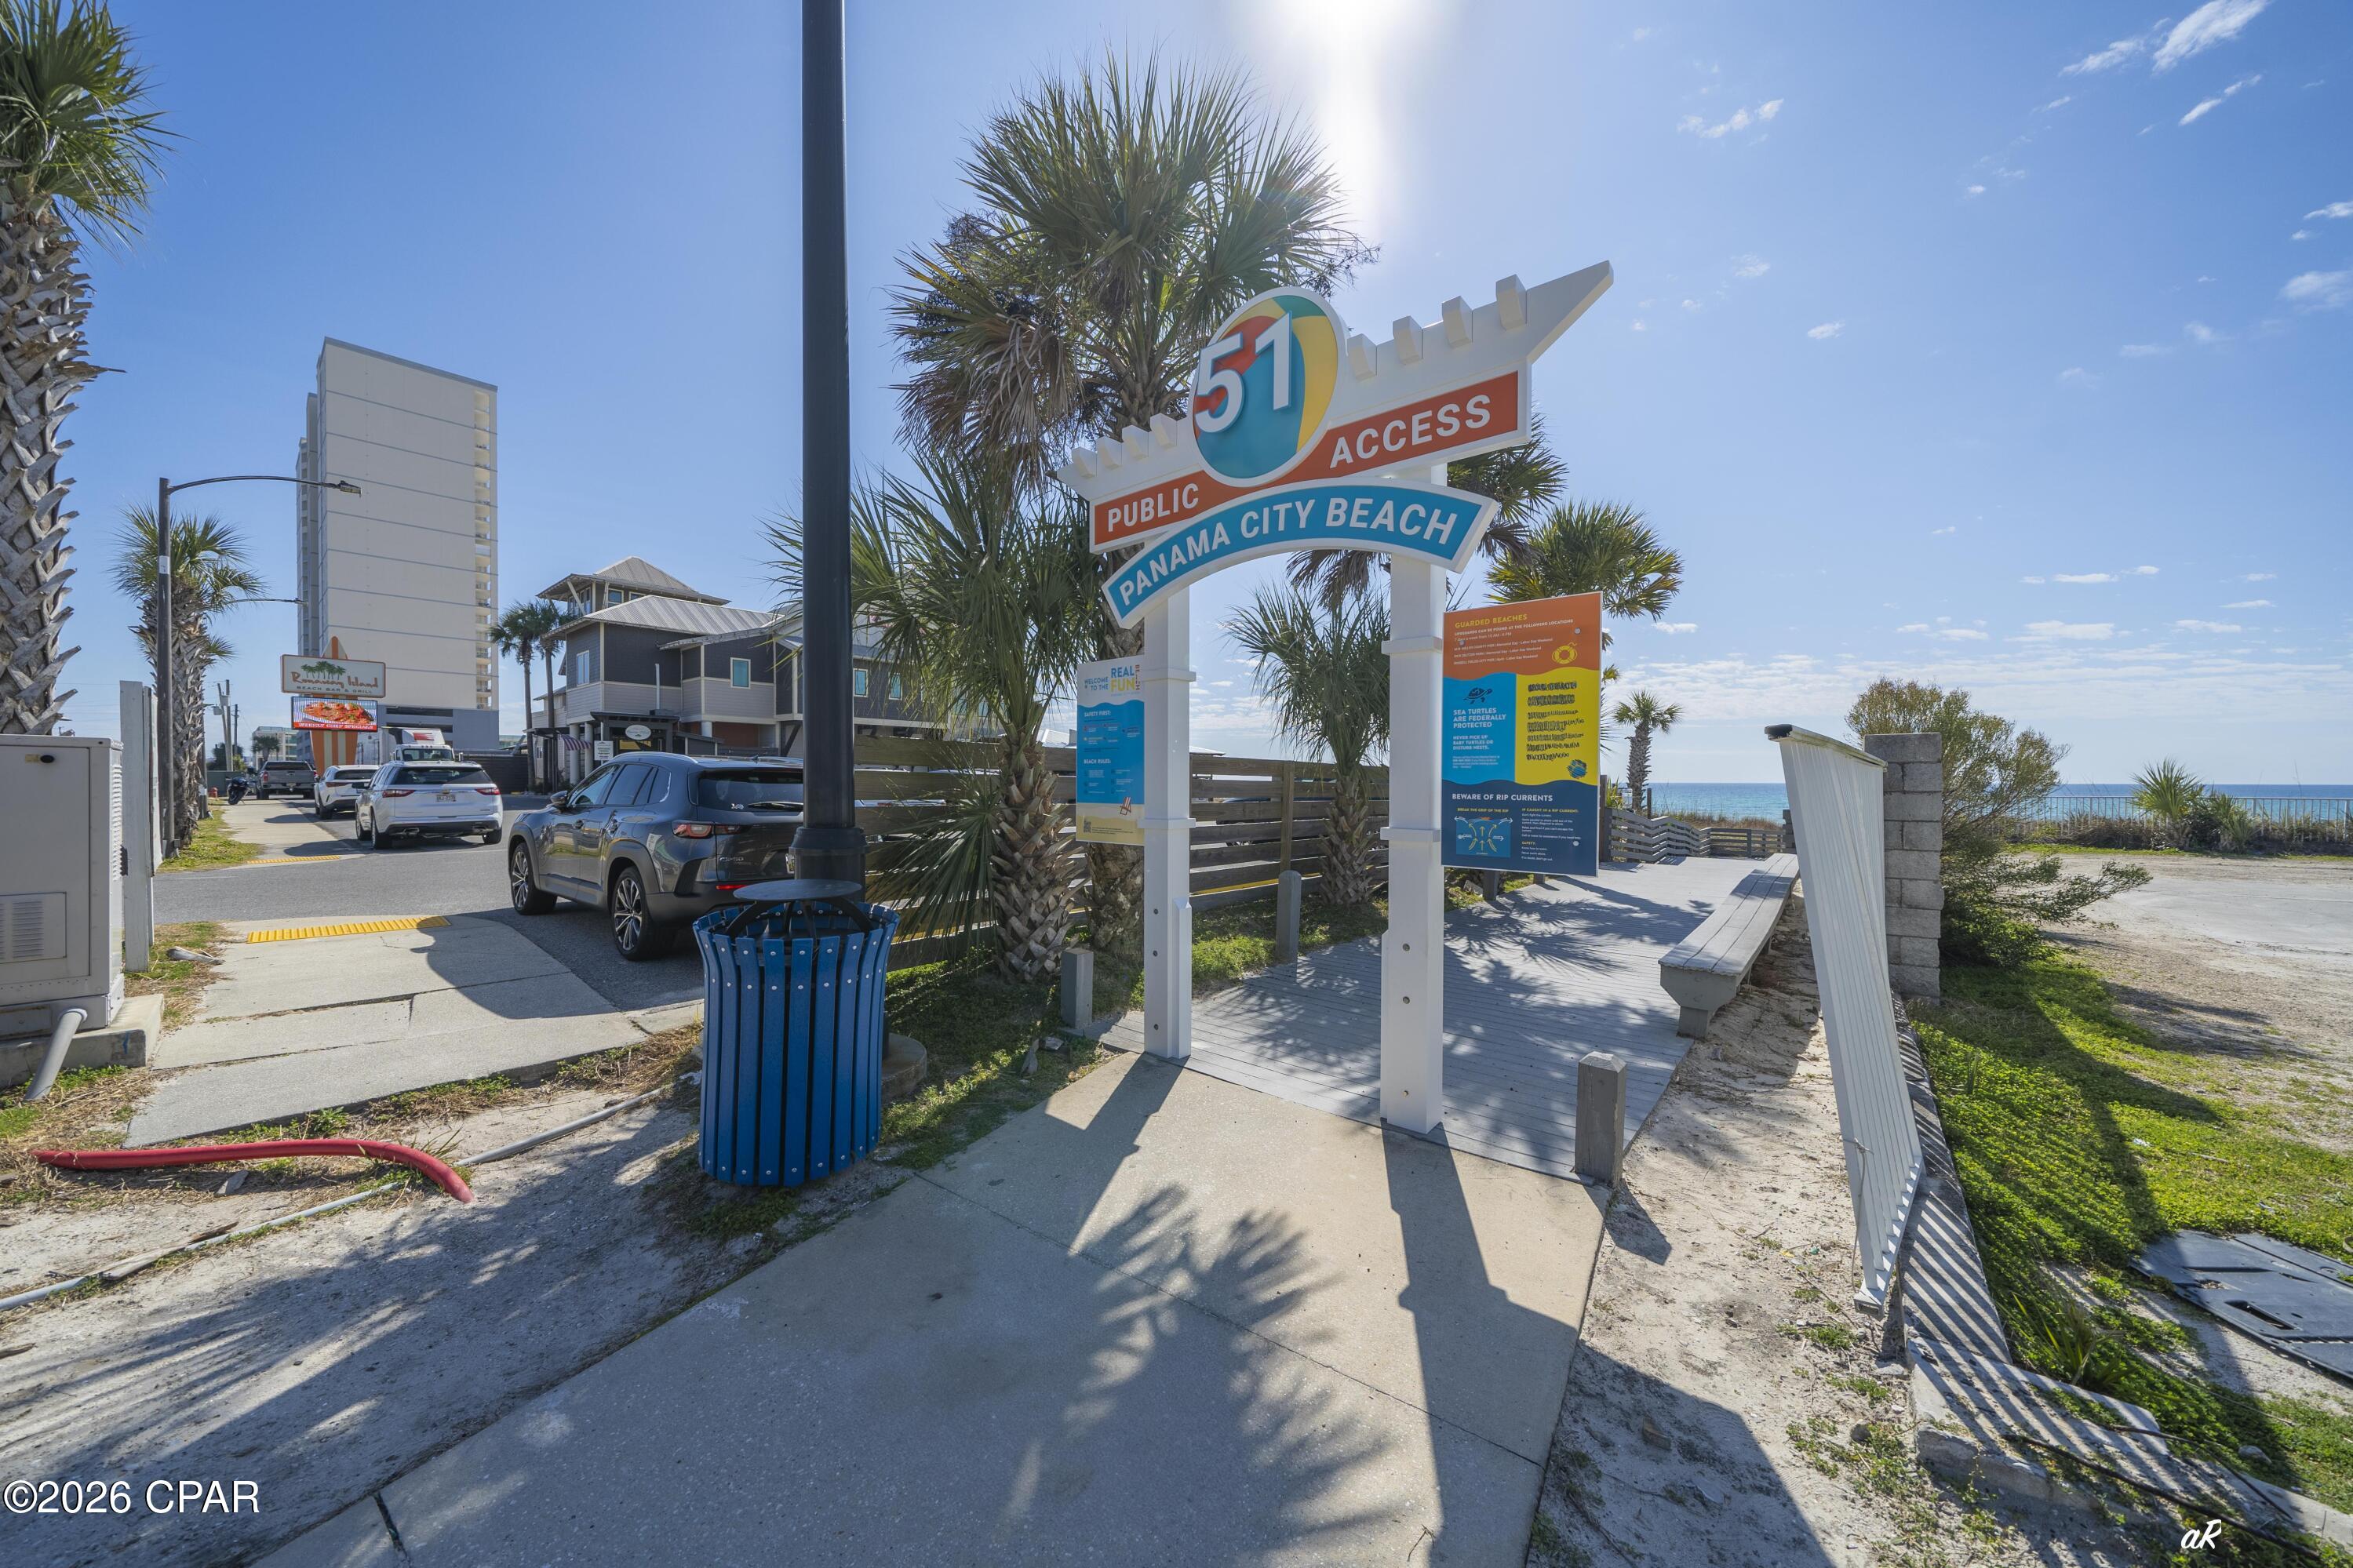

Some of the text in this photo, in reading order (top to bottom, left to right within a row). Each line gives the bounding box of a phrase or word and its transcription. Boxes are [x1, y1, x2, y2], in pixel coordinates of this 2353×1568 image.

[1195, 311, 1293, 436] 51
[1107, 394, 1492, 532] PUBLIC ACCESS
[1118, 497, 1458, 607] PANAMA CITY BEACH
[1455, 613, 1528, 628] GUARDED BEACHES
[1111, 665, 1135, 678] REAL
[1084, 676, 1109, 685] WELCOME
[1111, 678, 1135, 693] FUN
